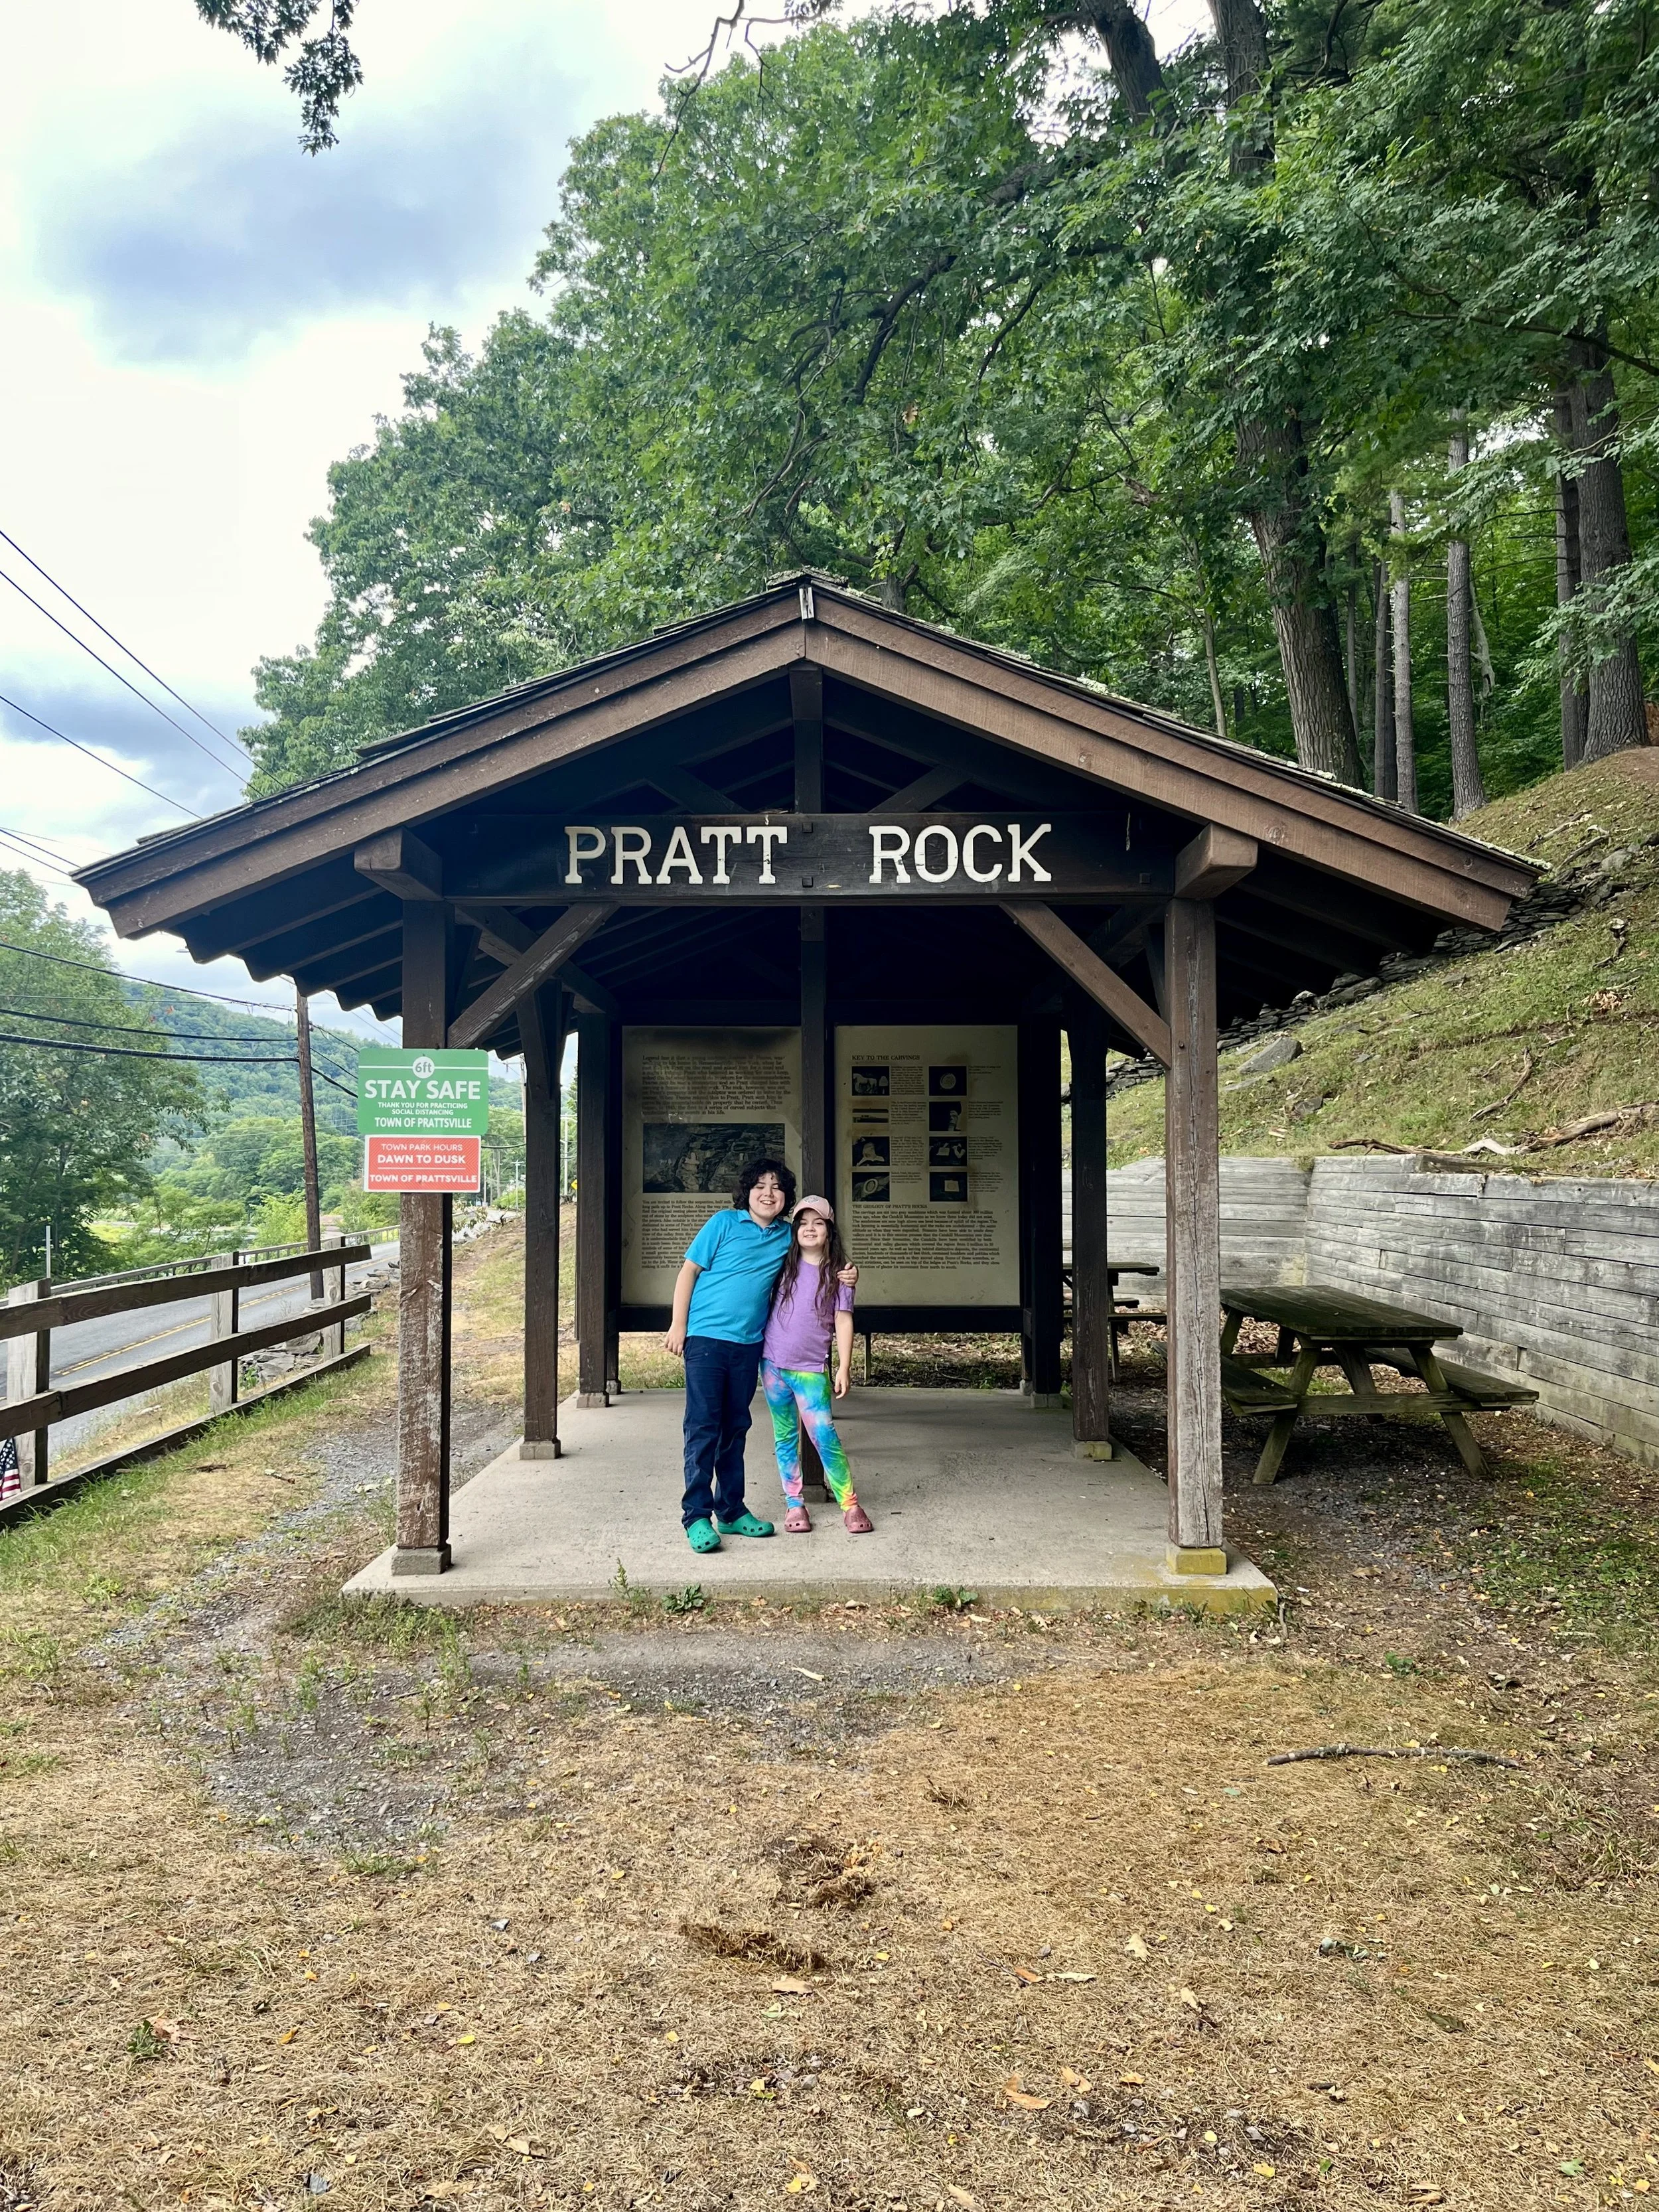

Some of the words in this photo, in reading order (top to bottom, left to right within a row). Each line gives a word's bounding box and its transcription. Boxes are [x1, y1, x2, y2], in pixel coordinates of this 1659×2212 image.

[565, 826, 788, 884] PRATT
[868, 823, 1052, 884] ROCK
[415, 1062, 431, 1073] 6ft
[365, 1080, 421, 1098] STAY
[426, 1080, 480, 1100] SAFE
[375, 1118, 402, 1128] TOWN
[404, 1118, 415, 1128] OF
[418, 1118, 472, 1128] PRATTSVILLE
[378, 1155, 413, 1163] DAWN
[416, 1155, 431, 1163] TO
[435, 1155, 465, 1163] DUSK
